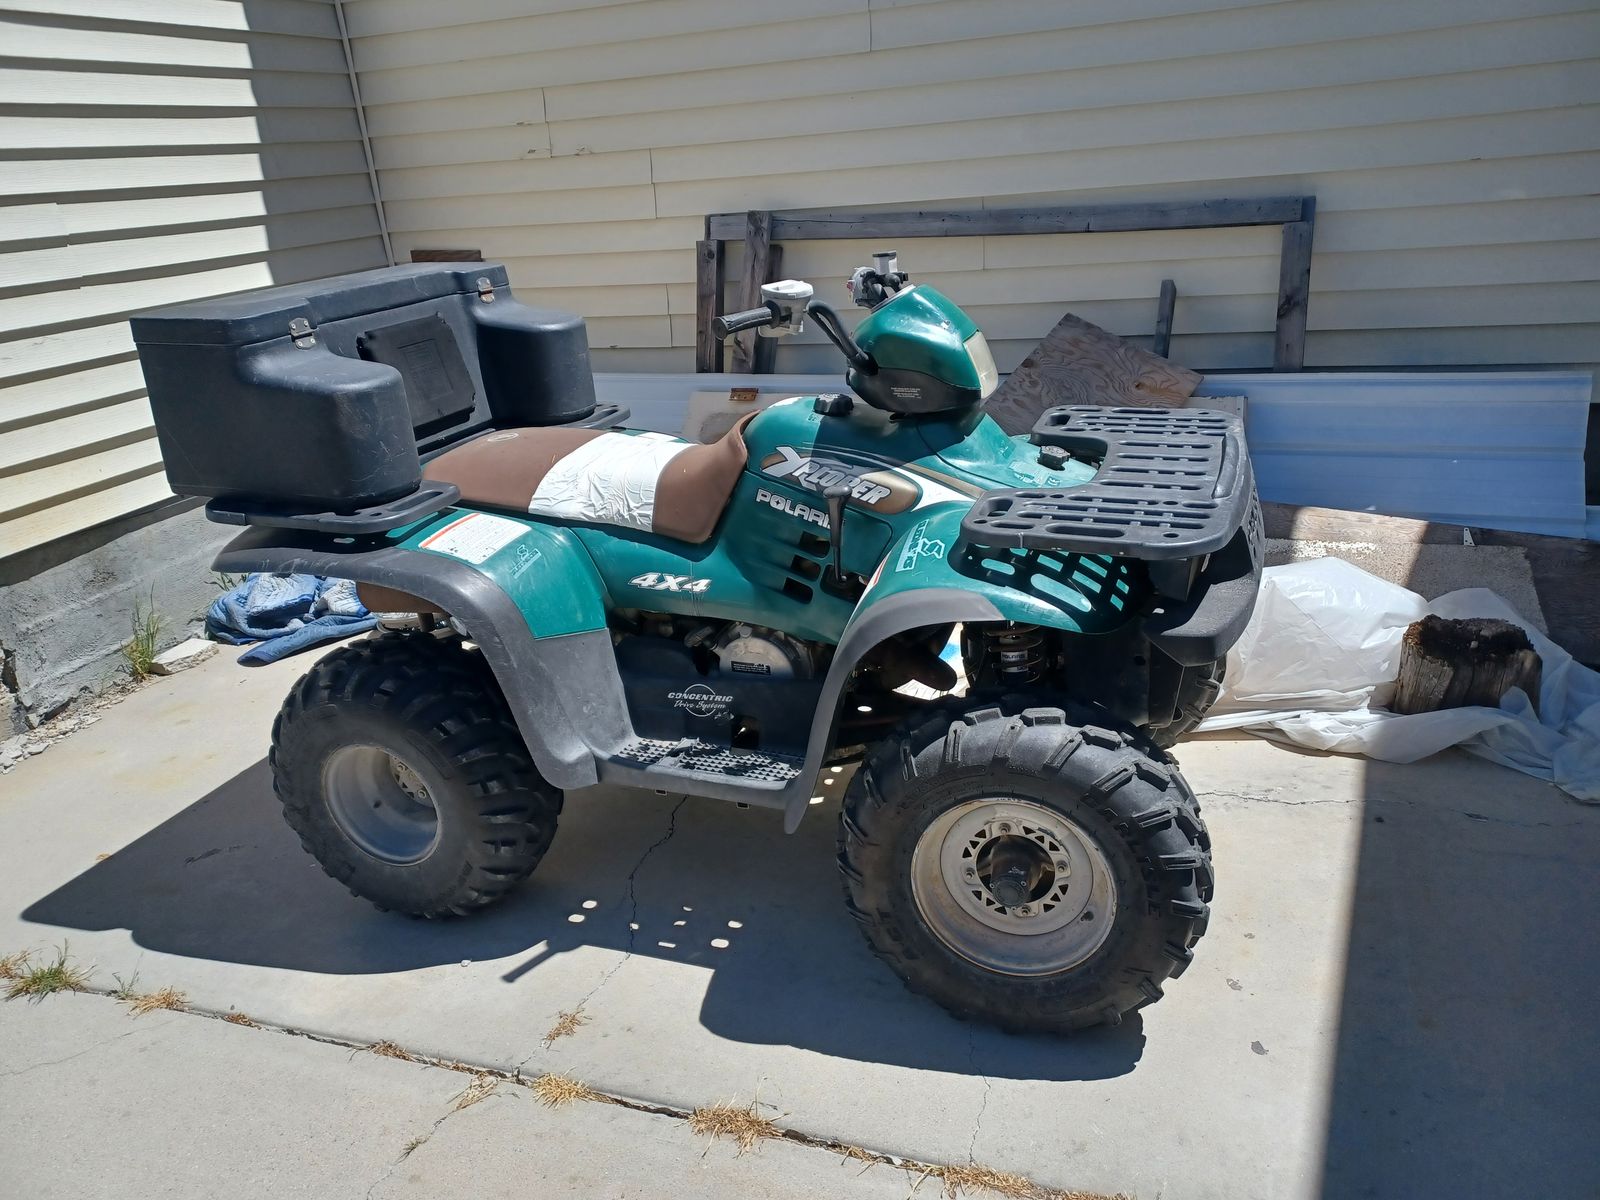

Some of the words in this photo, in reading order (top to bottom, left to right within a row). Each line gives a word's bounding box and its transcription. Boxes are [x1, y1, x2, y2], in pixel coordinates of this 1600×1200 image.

[756, 489, 831, 529] POLARI
[667, 692, 733, 702] CONCENTRIC
[673, 699, 695, 708] Drive
[696, 701, 726, 711] System
